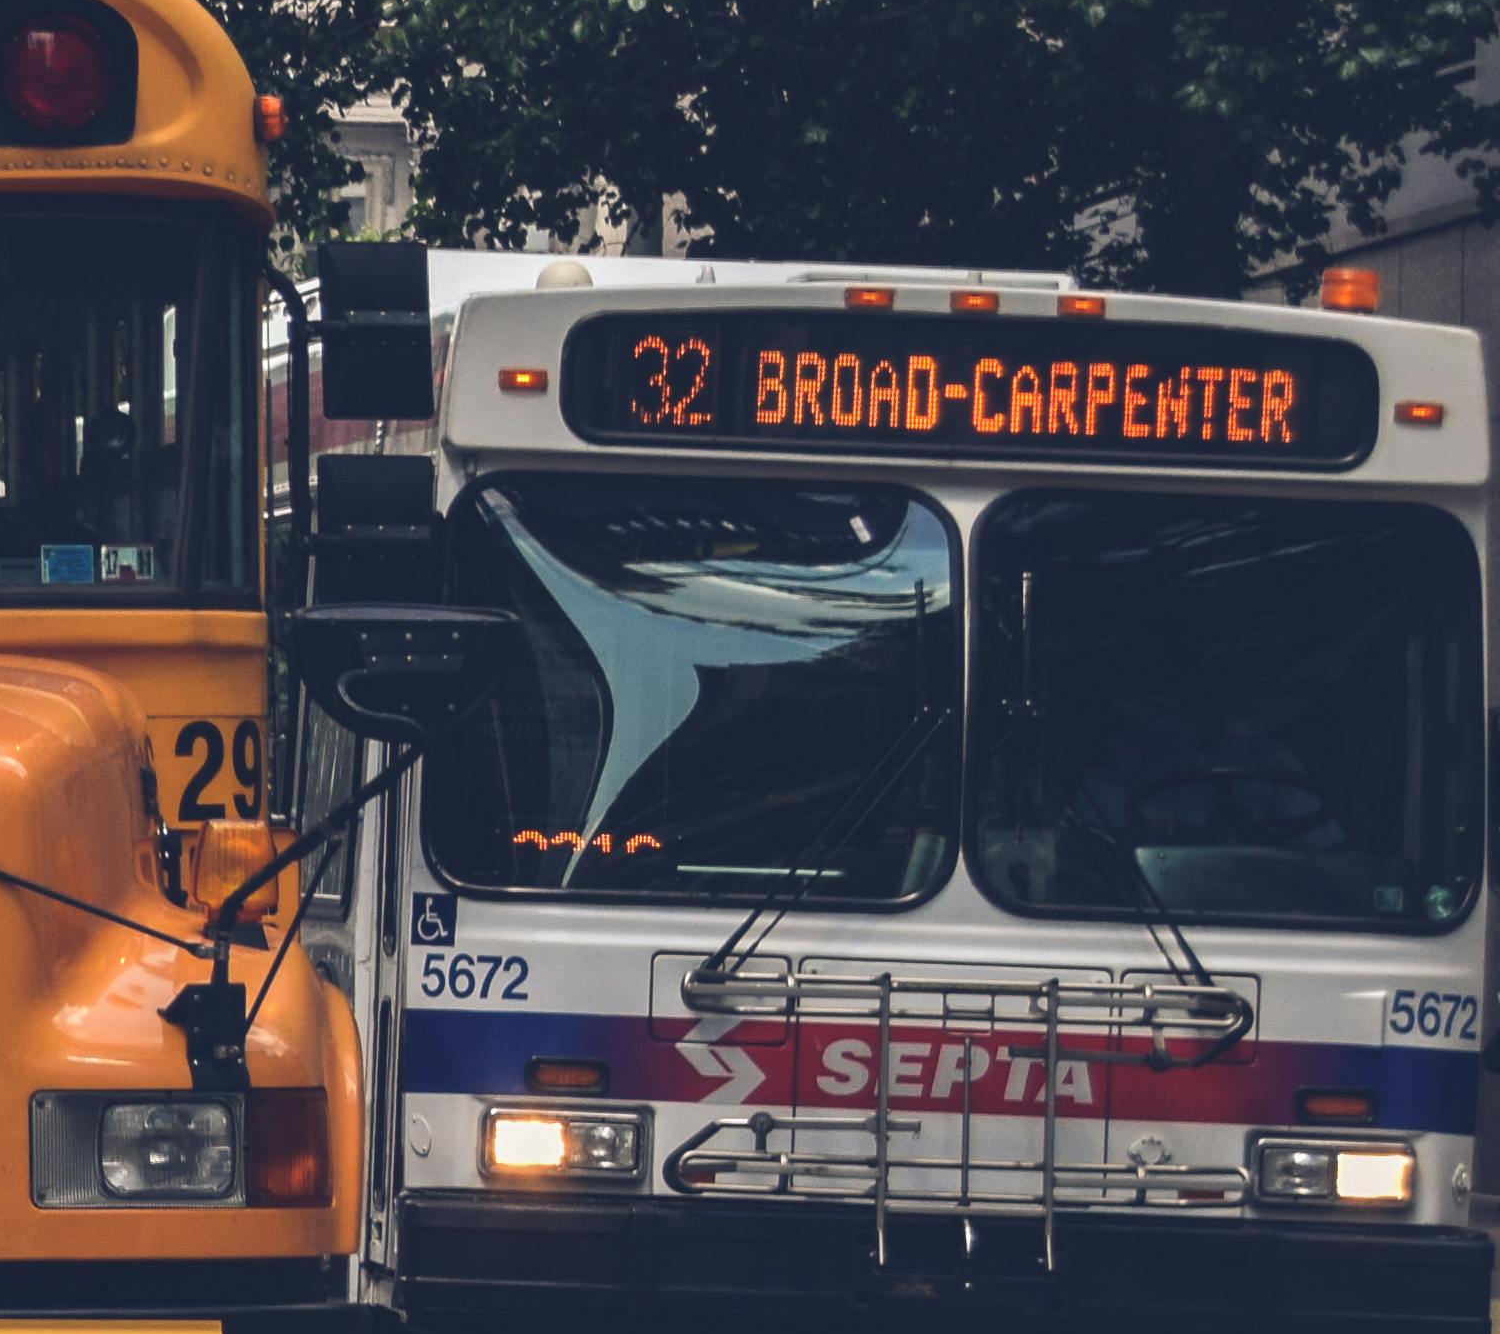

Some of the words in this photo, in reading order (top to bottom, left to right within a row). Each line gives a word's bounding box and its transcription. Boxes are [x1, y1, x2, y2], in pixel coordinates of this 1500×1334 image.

[631, 334, 713, 427] 32
[755, 349, 1296, 445] BROAD-CARPENTER
[174, 719, 262, 822] 29
[420, 953, 530, 1001] 5672
[1388, 989, 1478, 1041] 5672
[816, 1038, 1093, 1104] SEPTA
